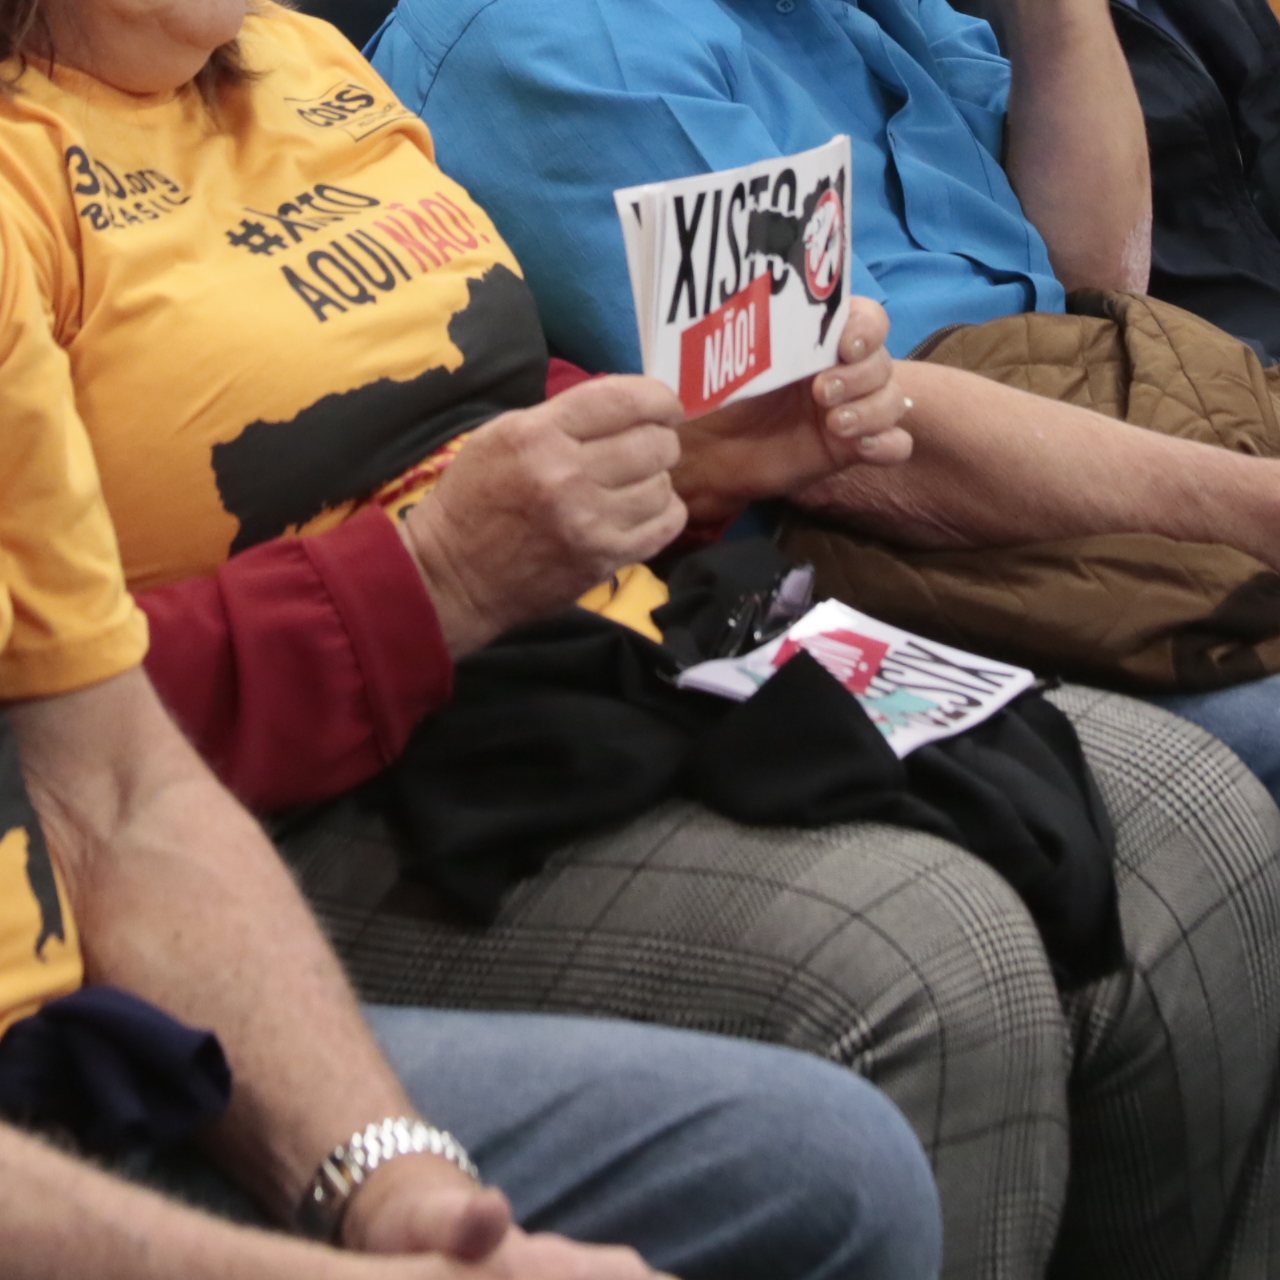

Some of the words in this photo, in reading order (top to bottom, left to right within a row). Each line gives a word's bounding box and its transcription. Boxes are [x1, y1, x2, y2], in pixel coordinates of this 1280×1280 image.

[280, 229, 412, 323] AQUI
[372, 191, 491, 273] NÃO!
[666, 167, 798, 325] XISTO
[702, 301, 756, 401] NÃO!
